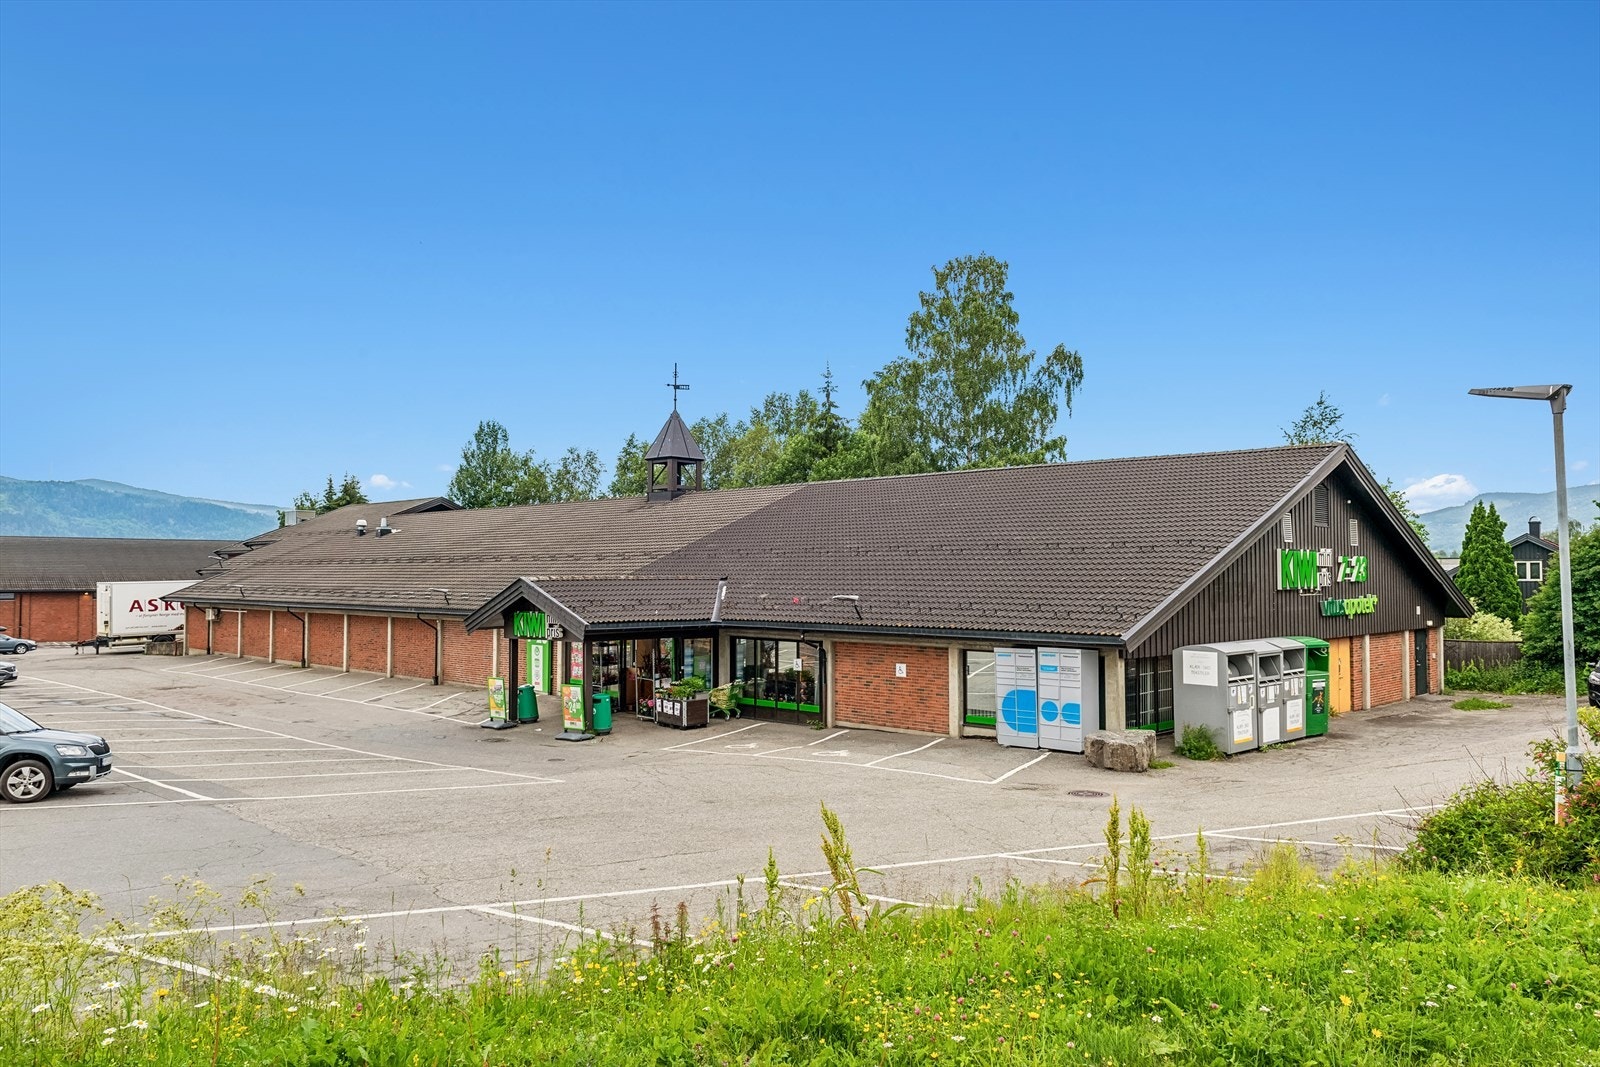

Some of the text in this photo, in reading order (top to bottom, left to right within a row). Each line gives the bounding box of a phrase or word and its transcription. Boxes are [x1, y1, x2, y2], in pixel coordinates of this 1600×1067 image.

[1278, 549, 1317, 590] KIWI
[1337, 555, 1368, 582] 7-23
[514, 611, 546, 638] KIWI
[547, 628, 561, 640] pris
